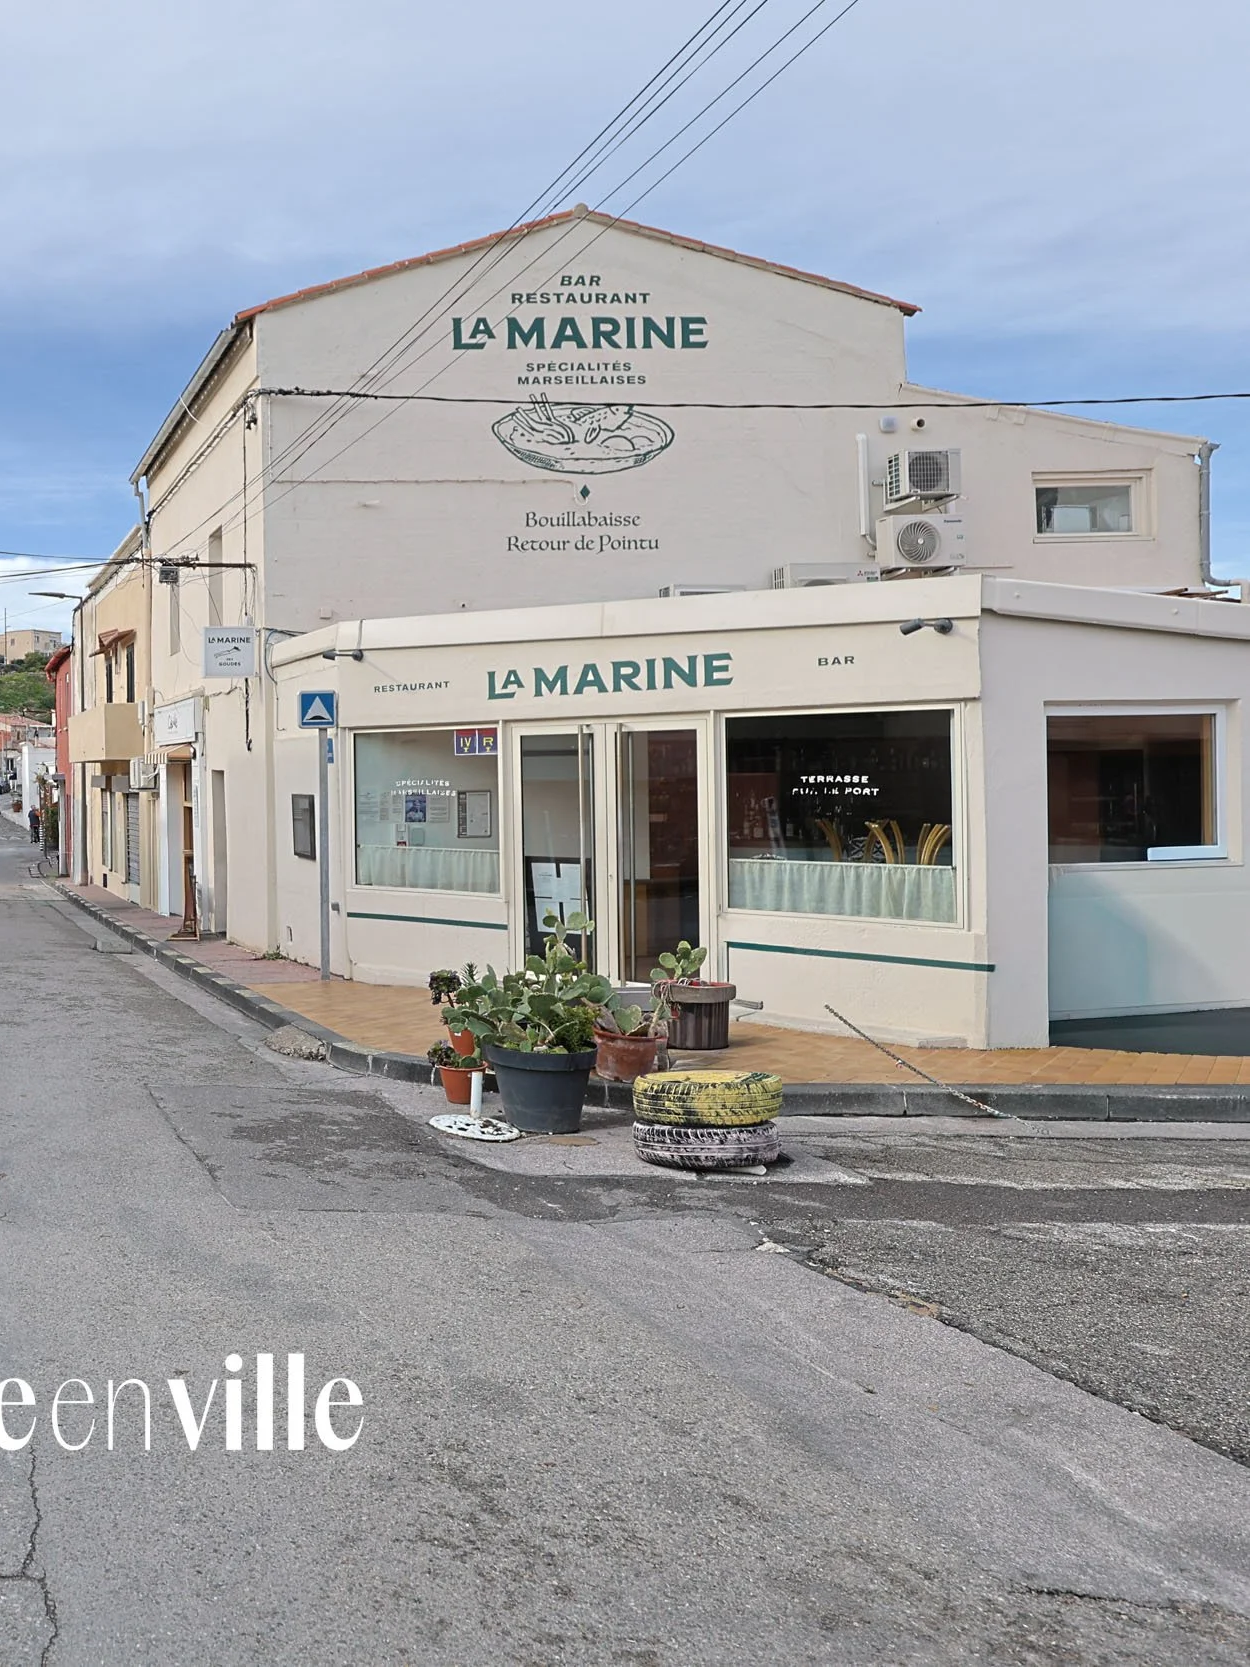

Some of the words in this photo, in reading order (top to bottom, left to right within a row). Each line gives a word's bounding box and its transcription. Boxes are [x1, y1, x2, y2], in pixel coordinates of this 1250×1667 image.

[559, 275, 601, 287] BAR
[511, 292, 650, 305] RESTAURANT
[452, 317, 496, 350] LA
[506, 316, 709, 350] MARINE
[526, 360, 632, 372] SPÉCIALITÉS
[517, 375, 646, 385] MARSEILLAISES
[525, 511, 641, 528] Bouillabaisse
[507, 536, 570, 552] Retour
[574, 535, 594, 551] de
[598, 535, 659, 553] Pointu
[374, 680, 450, 693] RESTAURANT
[487, 669, 525, 700] LA
[533, 652, 733, 697] MARINE
[817, 655, 855, 667] BAR
[800, 775, 869, 784] TERRASSE
[845, 787, 879, 796] PORT
